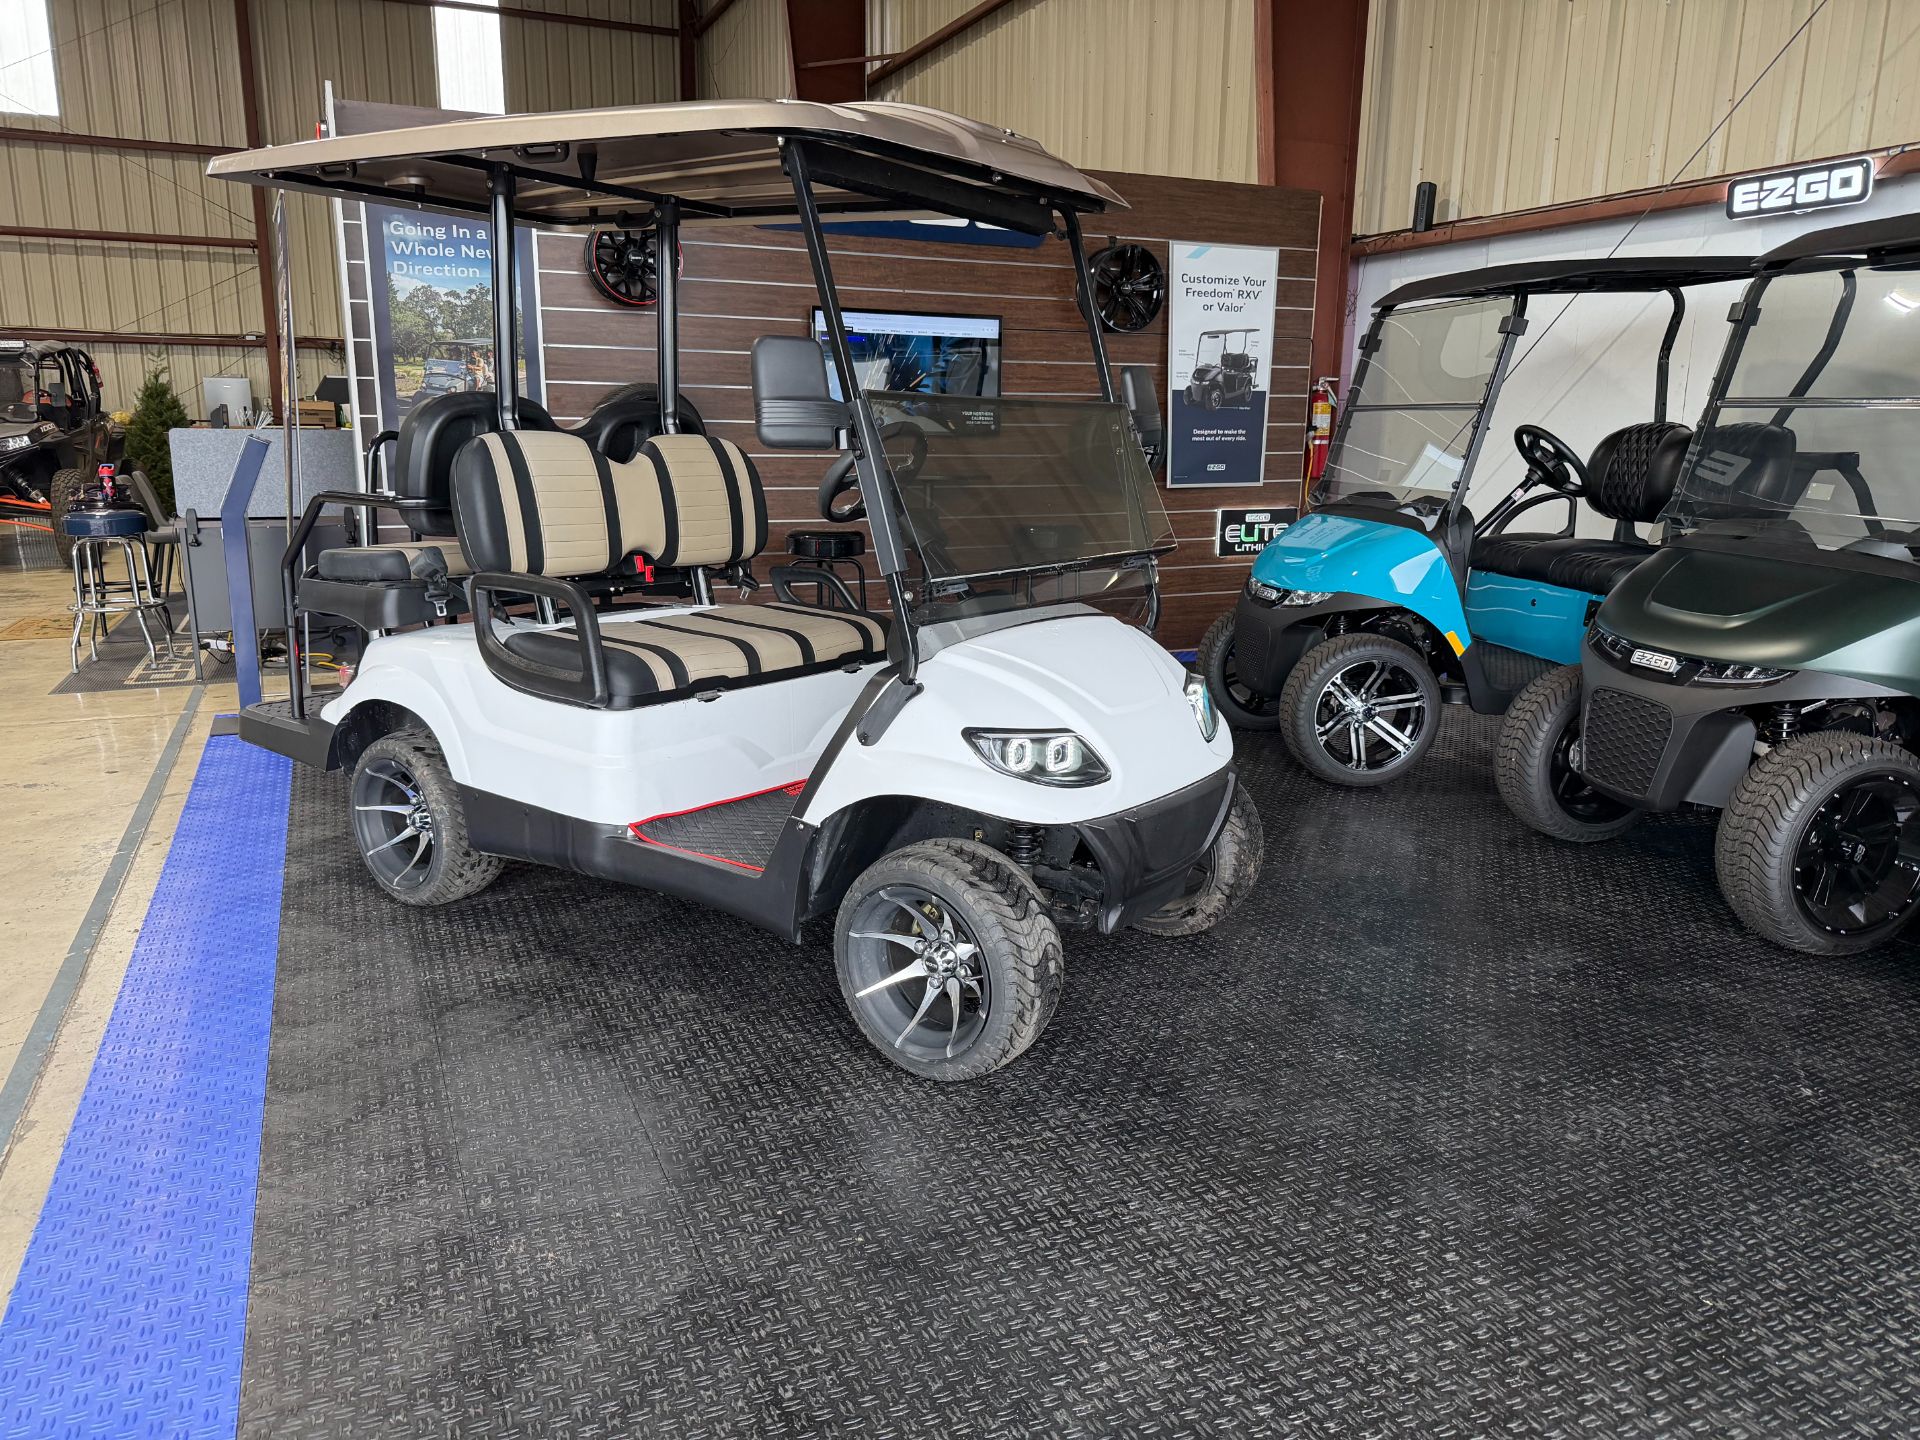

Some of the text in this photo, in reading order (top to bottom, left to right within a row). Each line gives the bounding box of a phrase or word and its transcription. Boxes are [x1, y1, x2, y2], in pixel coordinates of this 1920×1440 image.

[1732, 165, 1864, 213] EZGO
[389, 221, 487, 240] Going In a
[391, 241, 455, 257] Whole
[393, 261, 480, 278] Direction
[1181, 273, 1267, 287] Customize Your
[1202, 303, 1214, 311] or
[1633, 652, 1672, 669] EZGO
